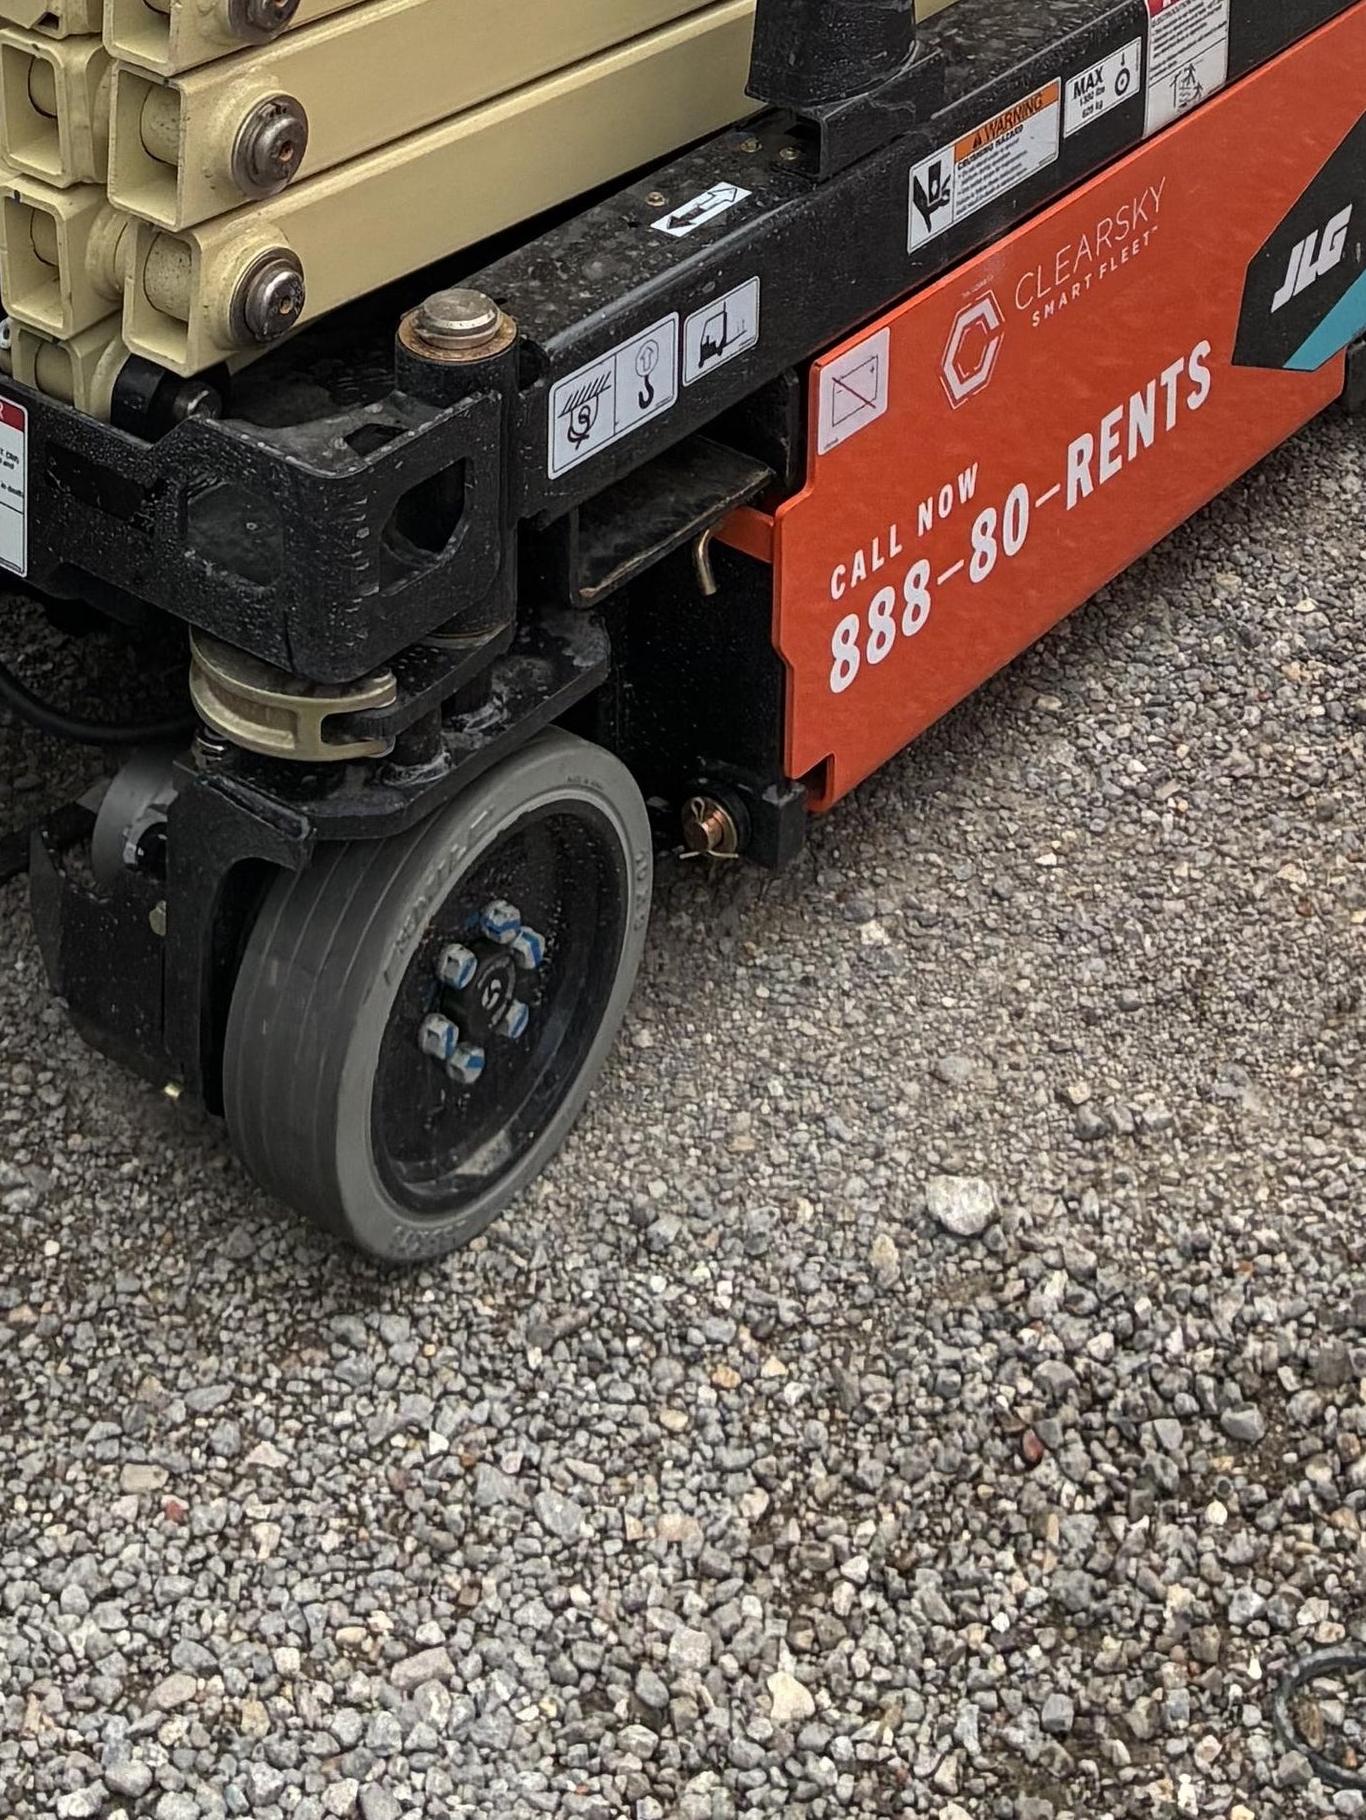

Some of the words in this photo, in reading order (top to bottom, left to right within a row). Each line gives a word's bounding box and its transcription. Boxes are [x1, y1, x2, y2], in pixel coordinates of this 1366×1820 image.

[985, 92, 1042, 140] WARNING
[1074, 65, 1103, 99] MAX
[1015, 176, 1166, 310] CLEARSKY
[1271, 203, 1353, 313] JLG
[1032, 273, 1093, 327] SMART
[830, 339, 1211, 694] 888-80-RENTS
[831, 523, 903, 601] CALL
[918, 462, 978, 537] NOW
